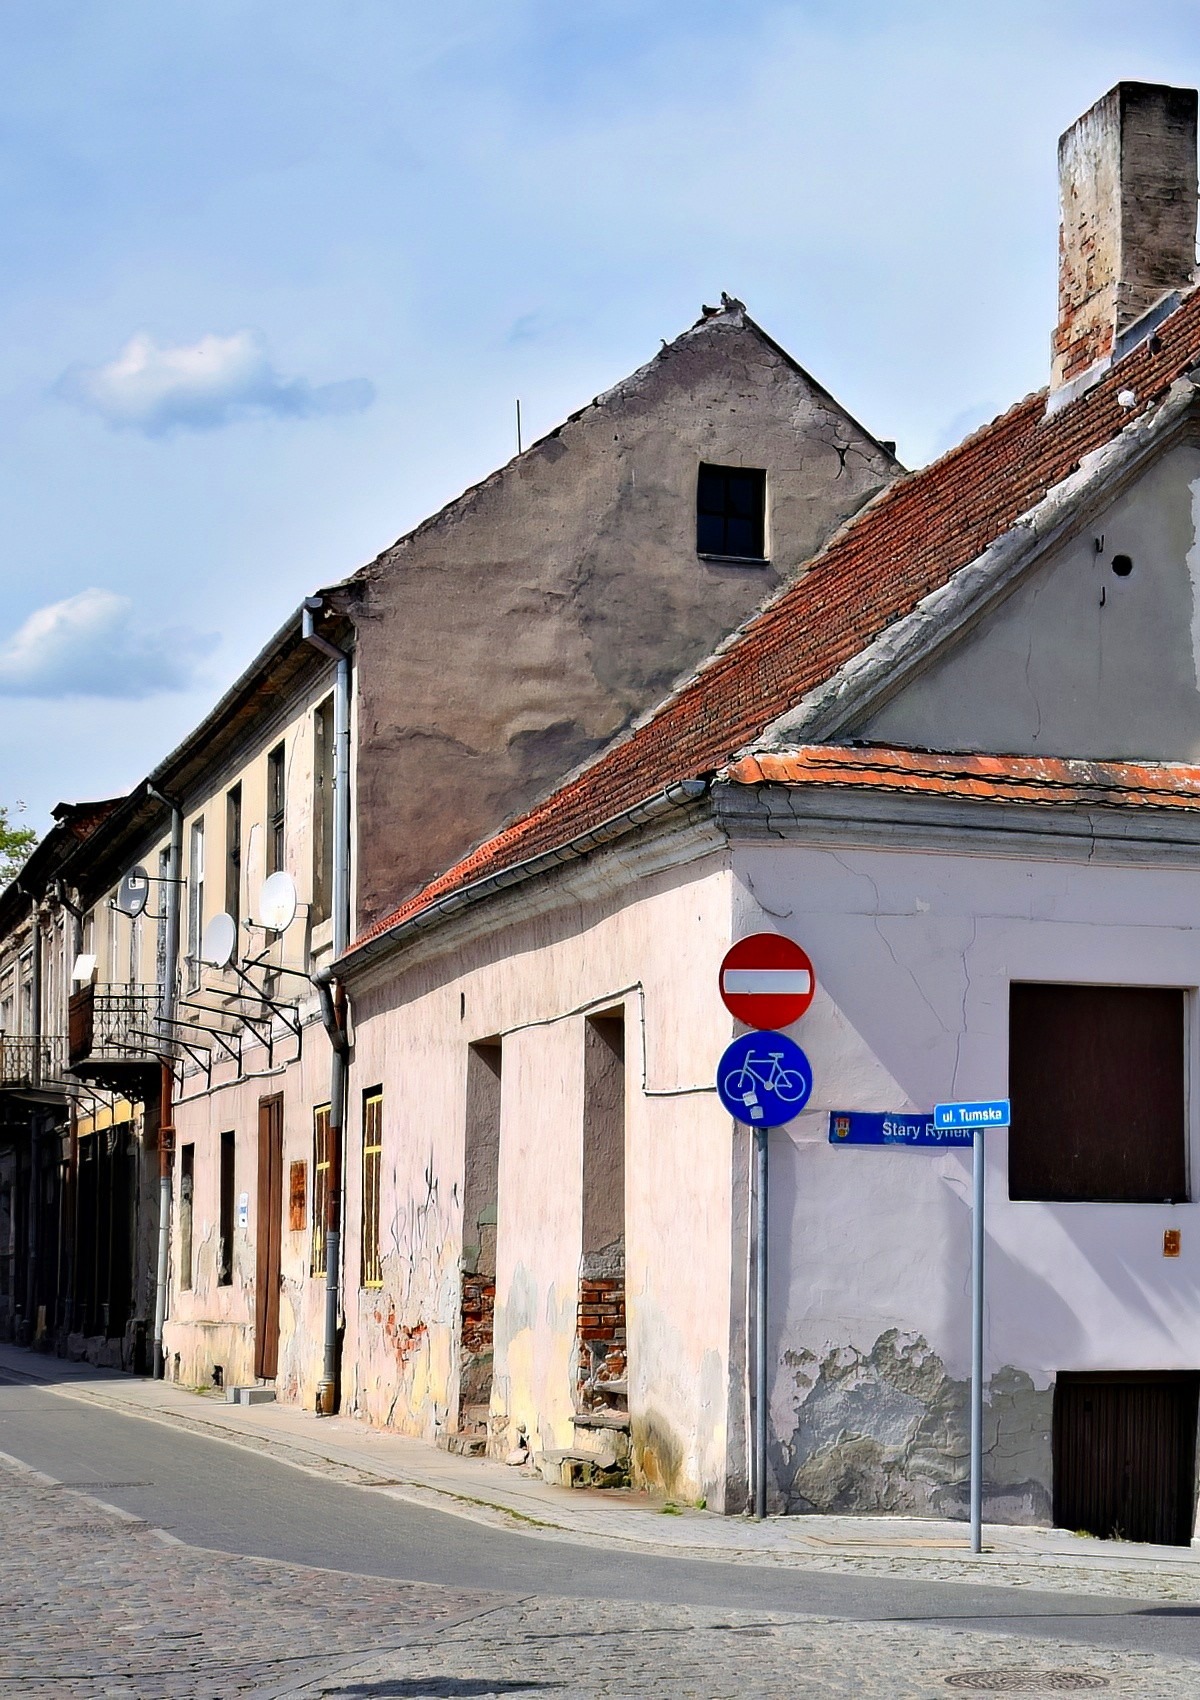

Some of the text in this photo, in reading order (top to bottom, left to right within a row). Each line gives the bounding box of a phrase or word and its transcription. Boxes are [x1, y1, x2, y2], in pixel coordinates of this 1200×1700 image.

[942, 1108, 1002, 1122] ul. Tumska
[882, 1121, 920, 1140] Stary
